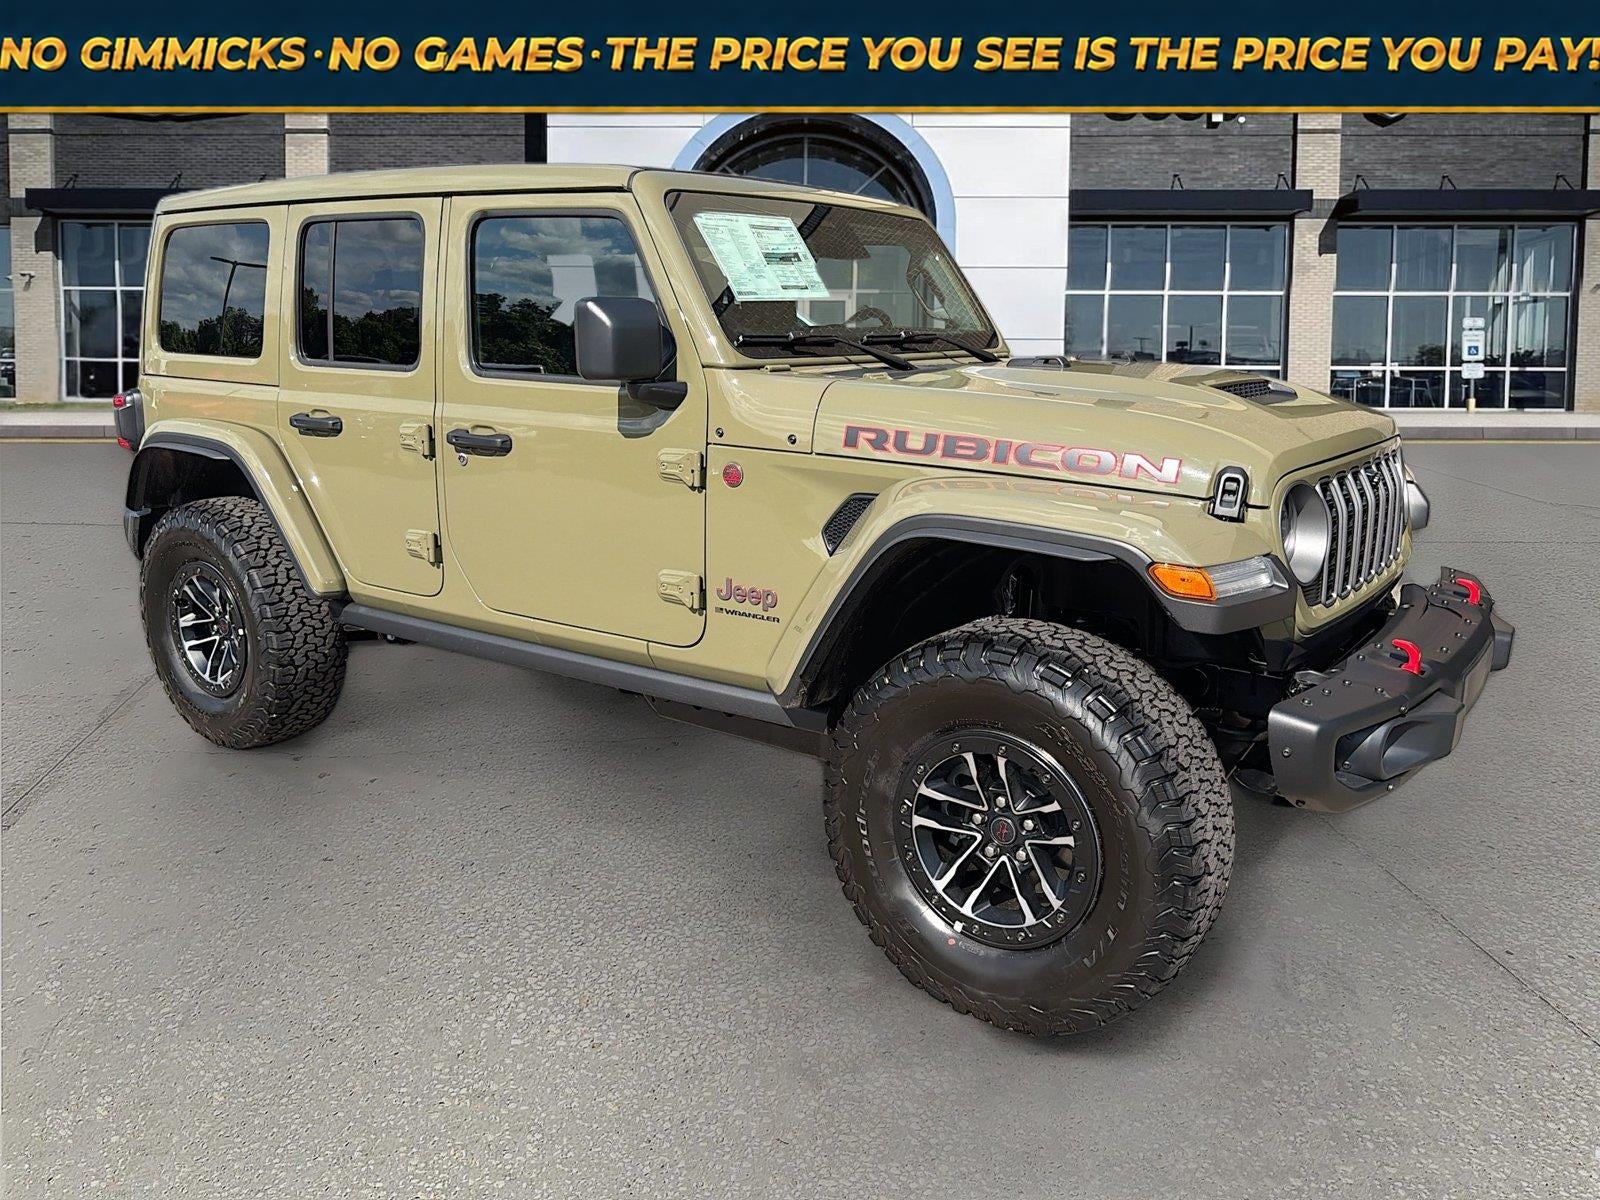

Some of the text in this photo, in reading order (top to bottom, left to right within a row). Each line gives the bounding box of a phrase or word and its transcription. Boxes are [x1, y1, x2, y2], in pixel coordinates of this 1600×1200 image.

[842, 425, 1184, 485] RUBICON
[716, 577, 778, 612] Jeep
[724, 608, 780, 624] WRANGLER
